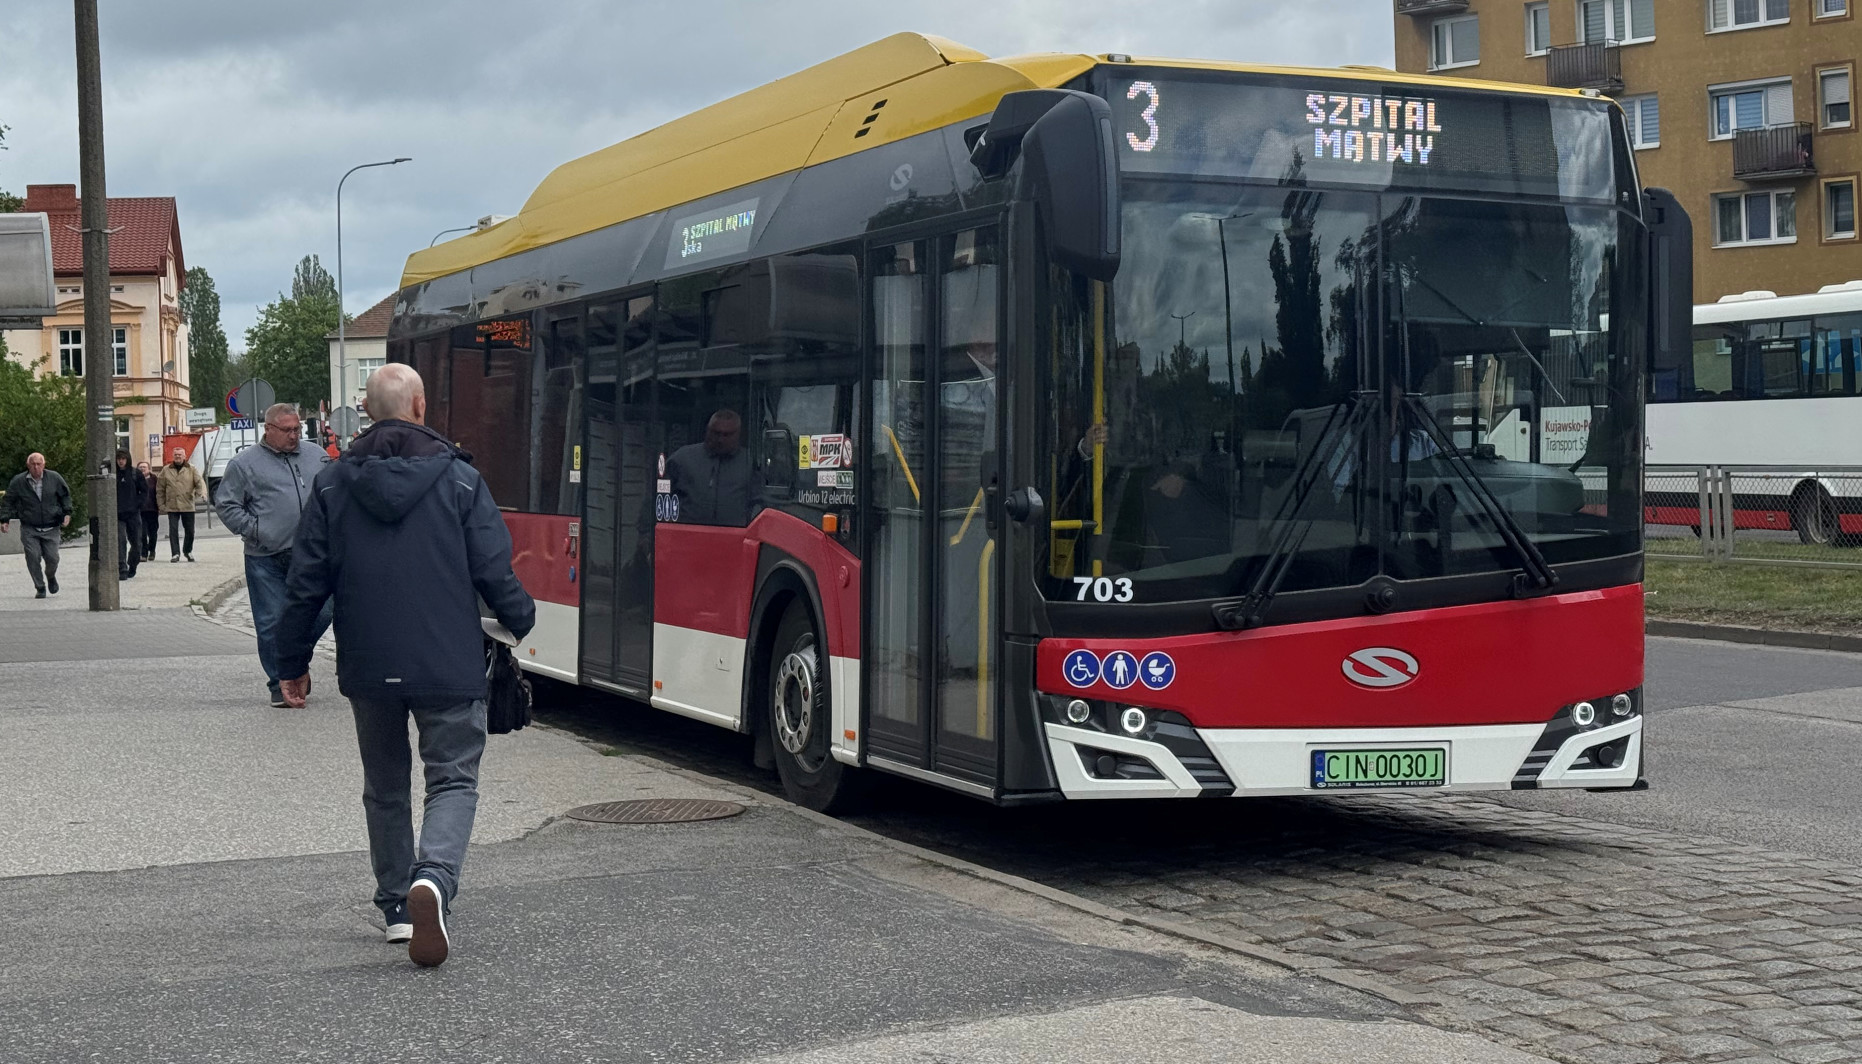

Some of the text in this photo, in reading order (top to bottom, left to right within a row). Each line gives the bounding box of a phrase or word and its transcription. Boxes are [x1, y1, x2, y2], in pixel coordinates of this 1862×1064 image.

[1126, 81, 1159, 151] 3
[1306, 94, 1442, 132] SZPITAL
[1314, 128, 1433, 164] MĄTWY
[690, 218, 723, 239] SZPITAL
[232, 419, 253, 429] TAXI
[820, 443, 841, 455] MPK
[1545, 437, 1579, 454] Transport
[798, 489, 855, 504] Urbino 12 electric
[1073, 576, 1134, 603] 703
[1326, 753, 1439, 779] CIN 0030J
